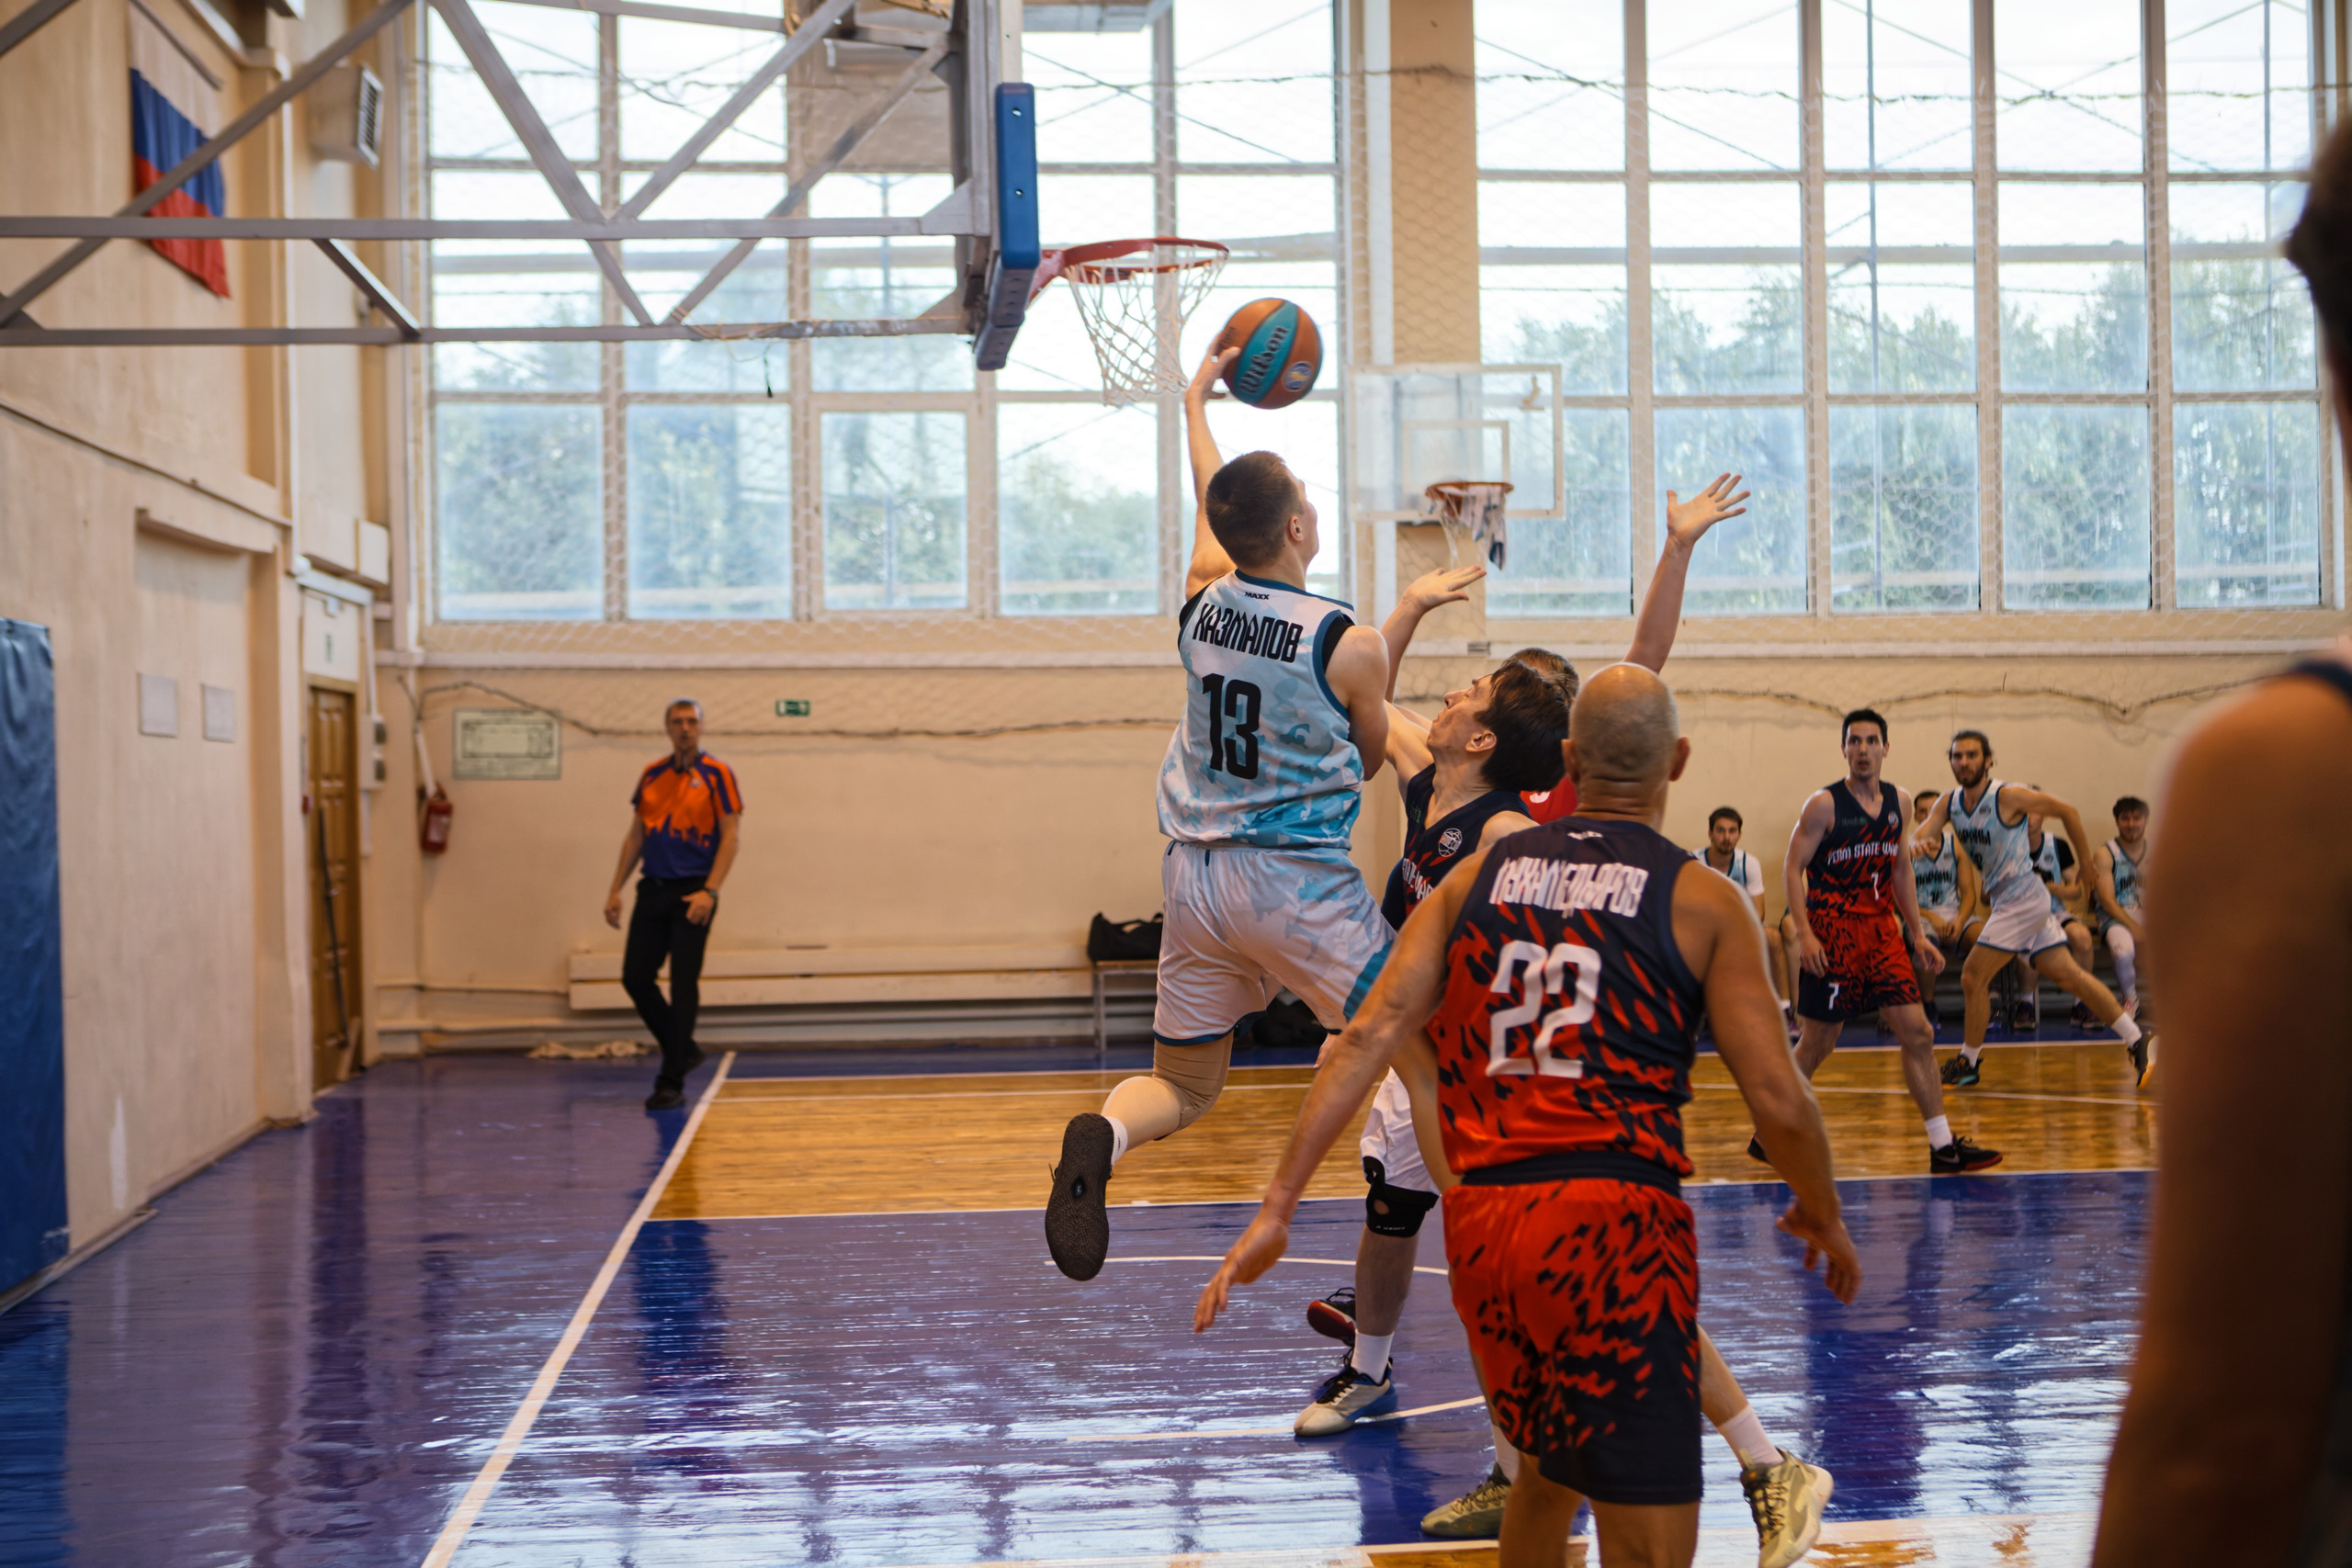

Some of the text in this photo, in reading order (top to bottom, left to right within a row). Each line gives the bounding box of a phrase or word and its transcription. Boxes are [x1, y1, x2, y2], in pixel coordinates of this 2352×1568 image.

[1238, 325, 1289, 394] Wilson
[1244, 591, 1271, 601] MAXX
[1192, 602, 1304, 663] КАЗМАЛОВ
[1202, 672, 1261, 780] 13
[1854, 841, 1880, 859] STATE
[1871, 872, 1879, 900] 7
[1485, 939, 1602, 1079] 22
[1828, 983, 1839, 1010] 7
